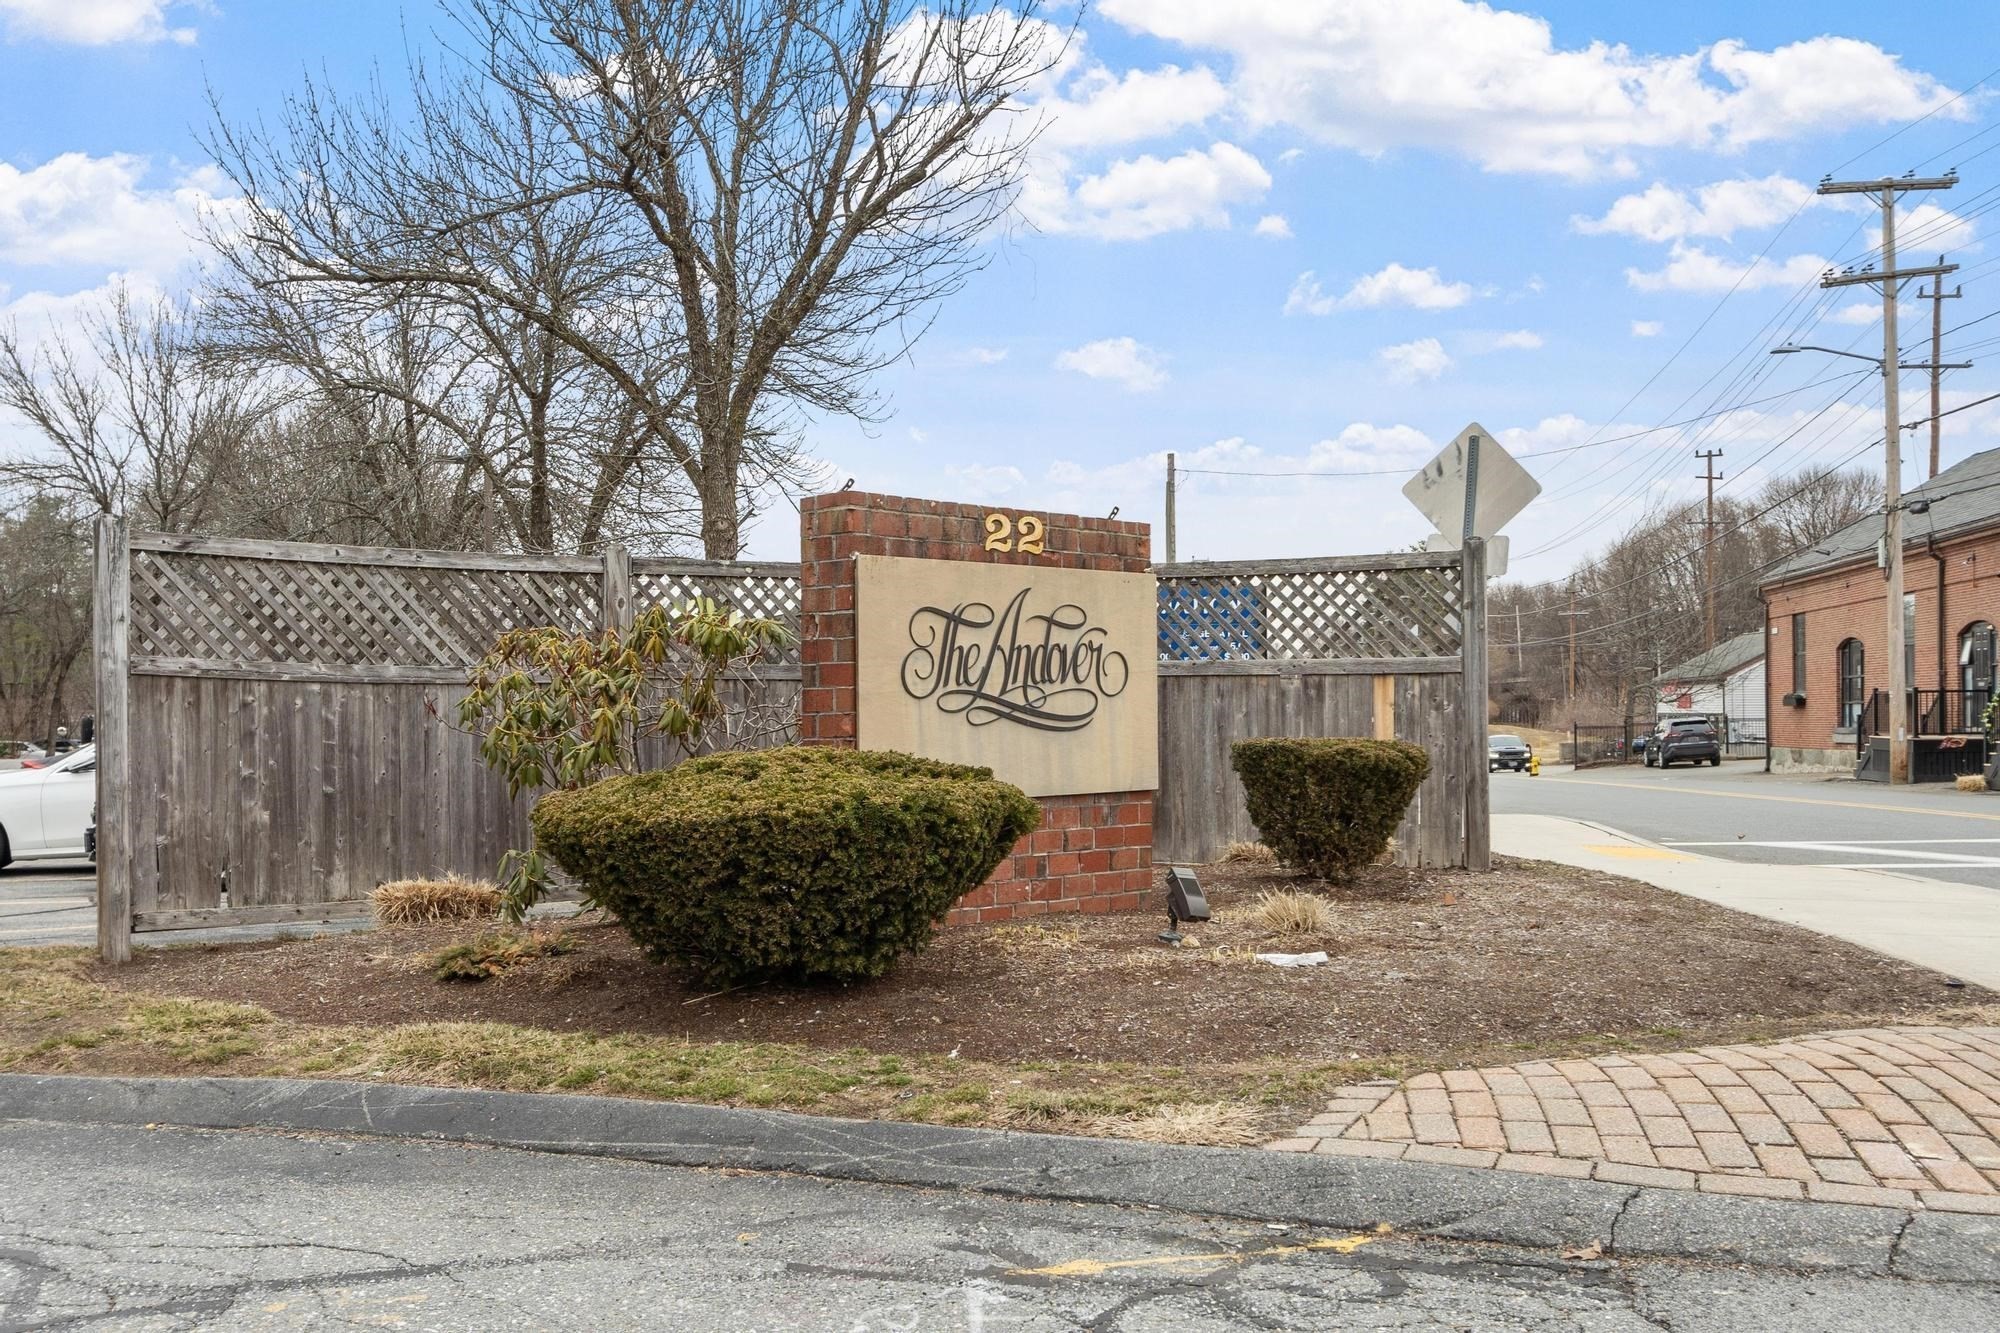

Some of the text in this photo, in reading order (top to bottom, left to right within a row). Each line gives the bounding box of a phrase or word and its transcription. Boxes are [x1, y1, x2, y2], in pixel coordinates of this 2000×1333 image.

[984, 513, 1045, 555] 22
[901, 587, 1129, 731] The Andover
